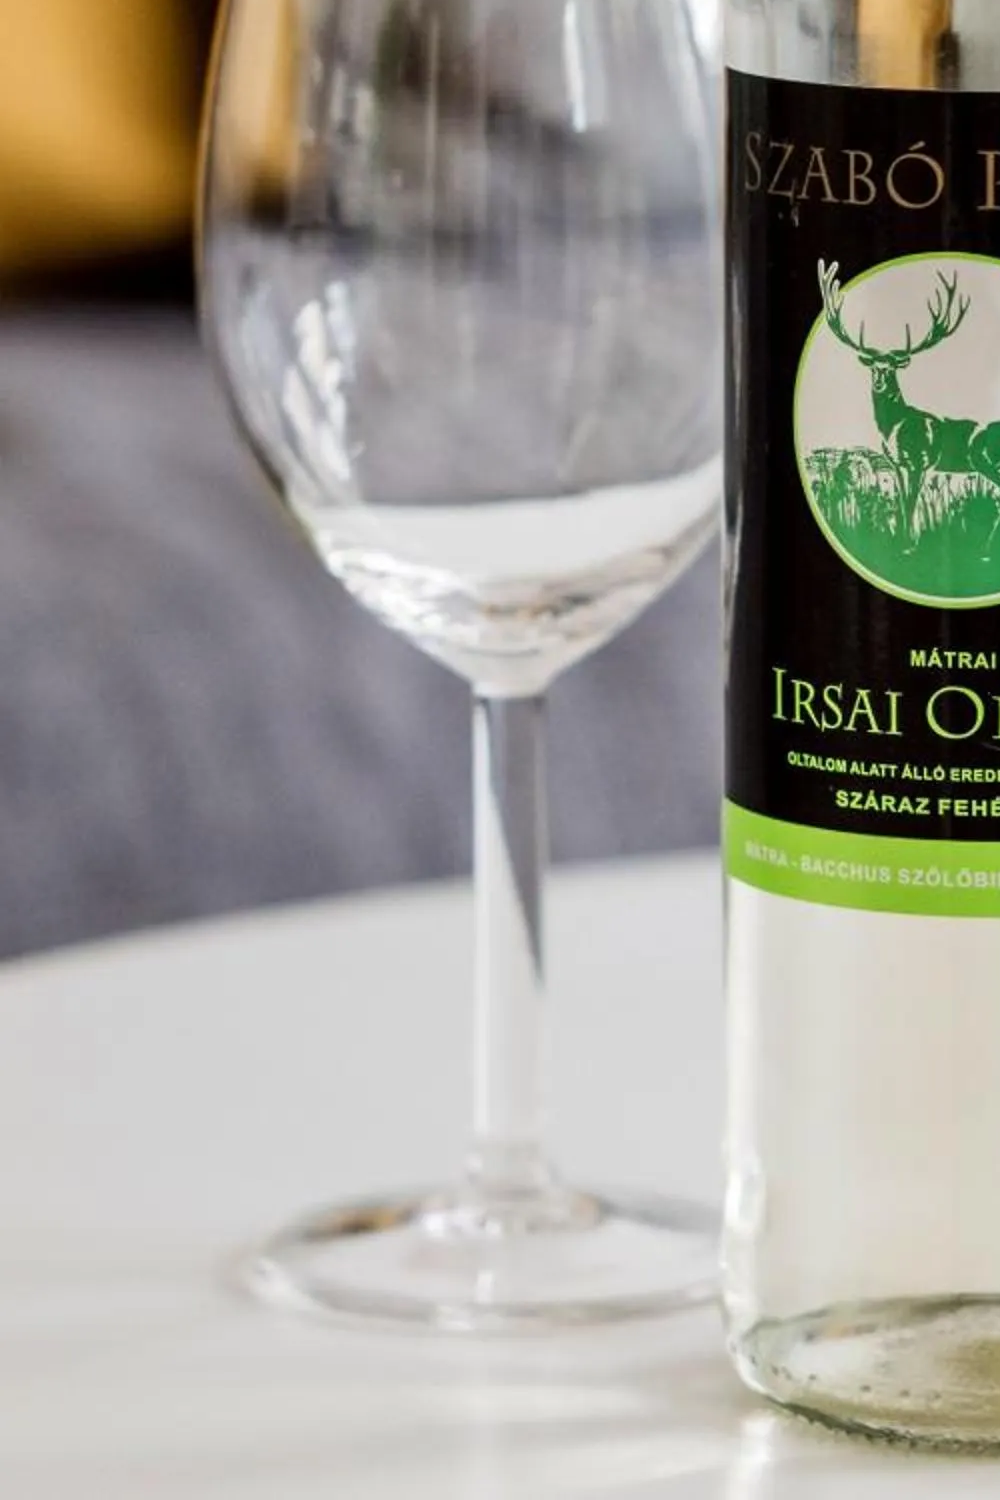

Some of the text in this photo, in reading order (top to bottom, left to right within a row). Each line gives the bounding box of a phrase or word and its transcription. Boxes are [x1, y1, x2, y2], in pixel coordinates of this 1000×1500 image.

[743, 131, 946, 210] SZABÓ
[909, 647, 998, 669] MÁTRAI
[771, 666, 903, 737] IRSAI
[787, 751, 847, 773] OLTALOM
[850, 760, 899, 778] ALATT
[901, 763, 945, 781] ÁLLÓ
[835, 789, 932, 815] SZÁRAZ
[801, 854, 892, 884] BACCHUS
